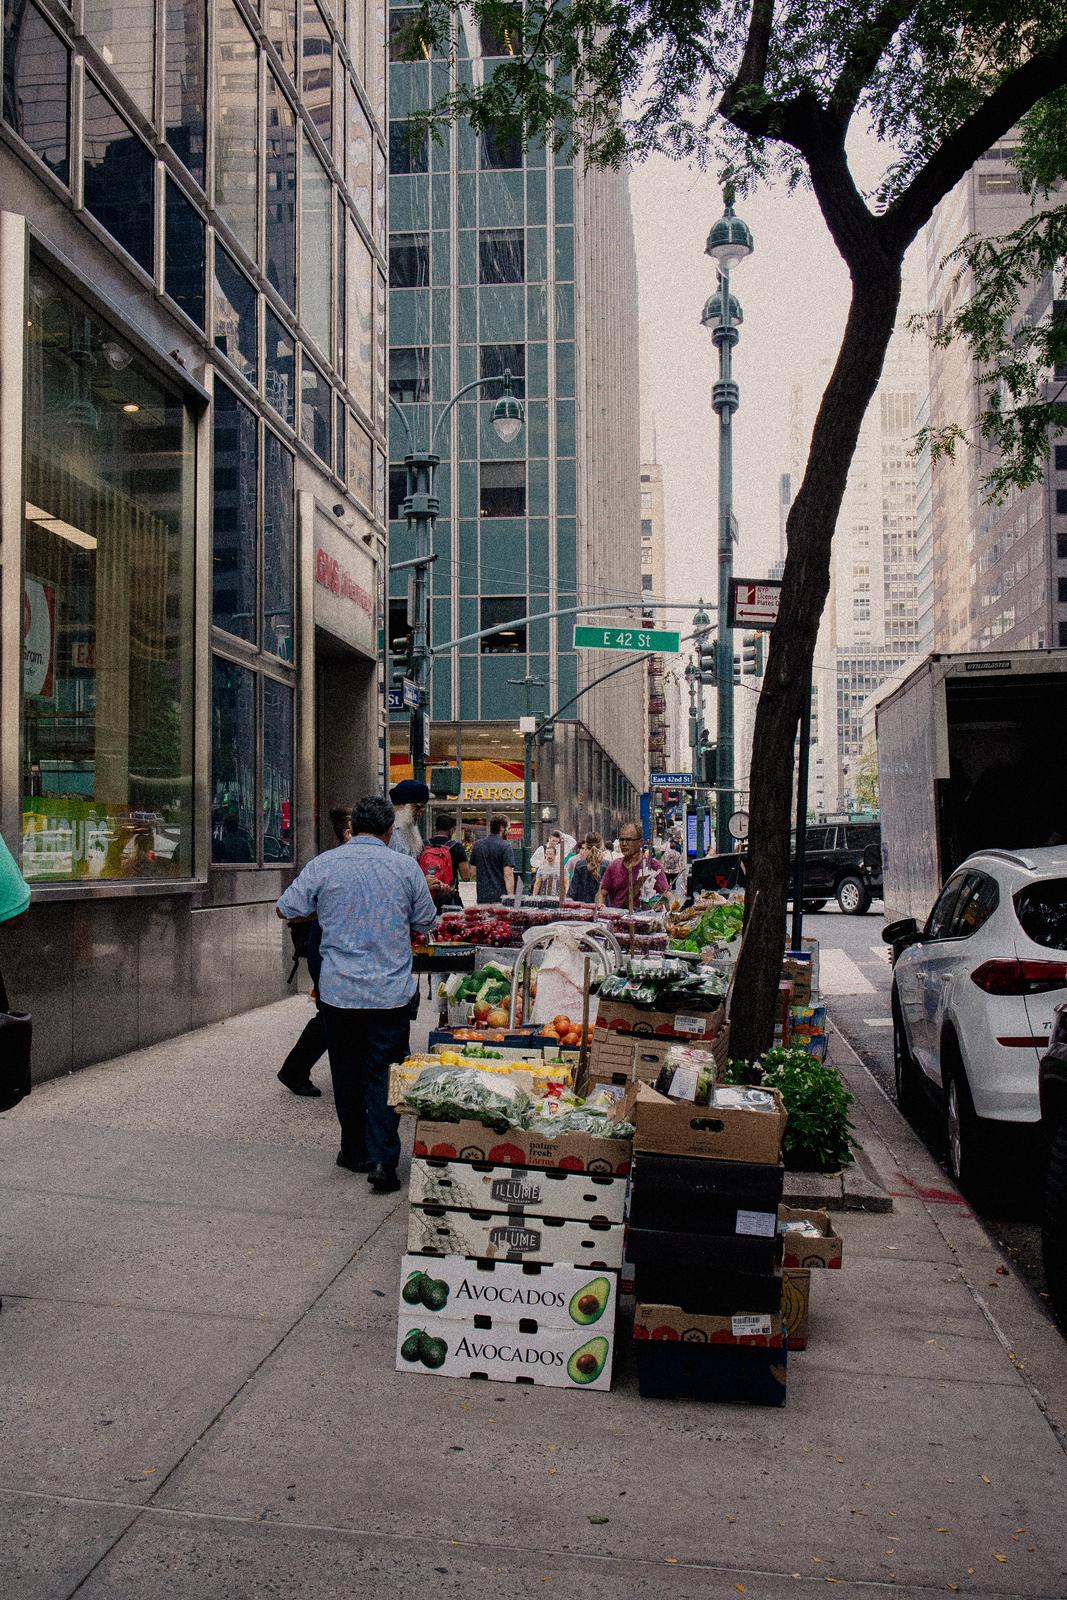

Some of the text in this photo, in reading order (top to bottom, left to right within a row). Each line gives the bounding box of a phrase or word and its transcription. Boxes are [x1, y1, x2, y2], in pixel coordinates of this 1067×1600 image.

[603, 631, 651, 647] E 42 St
[463, 786, 525, 801] FARGO
[529, 1142, 560, 1151] nature
[529, 1149, 553, 1158] fresh
[496, 1184, 540, 1199] ILLUME
